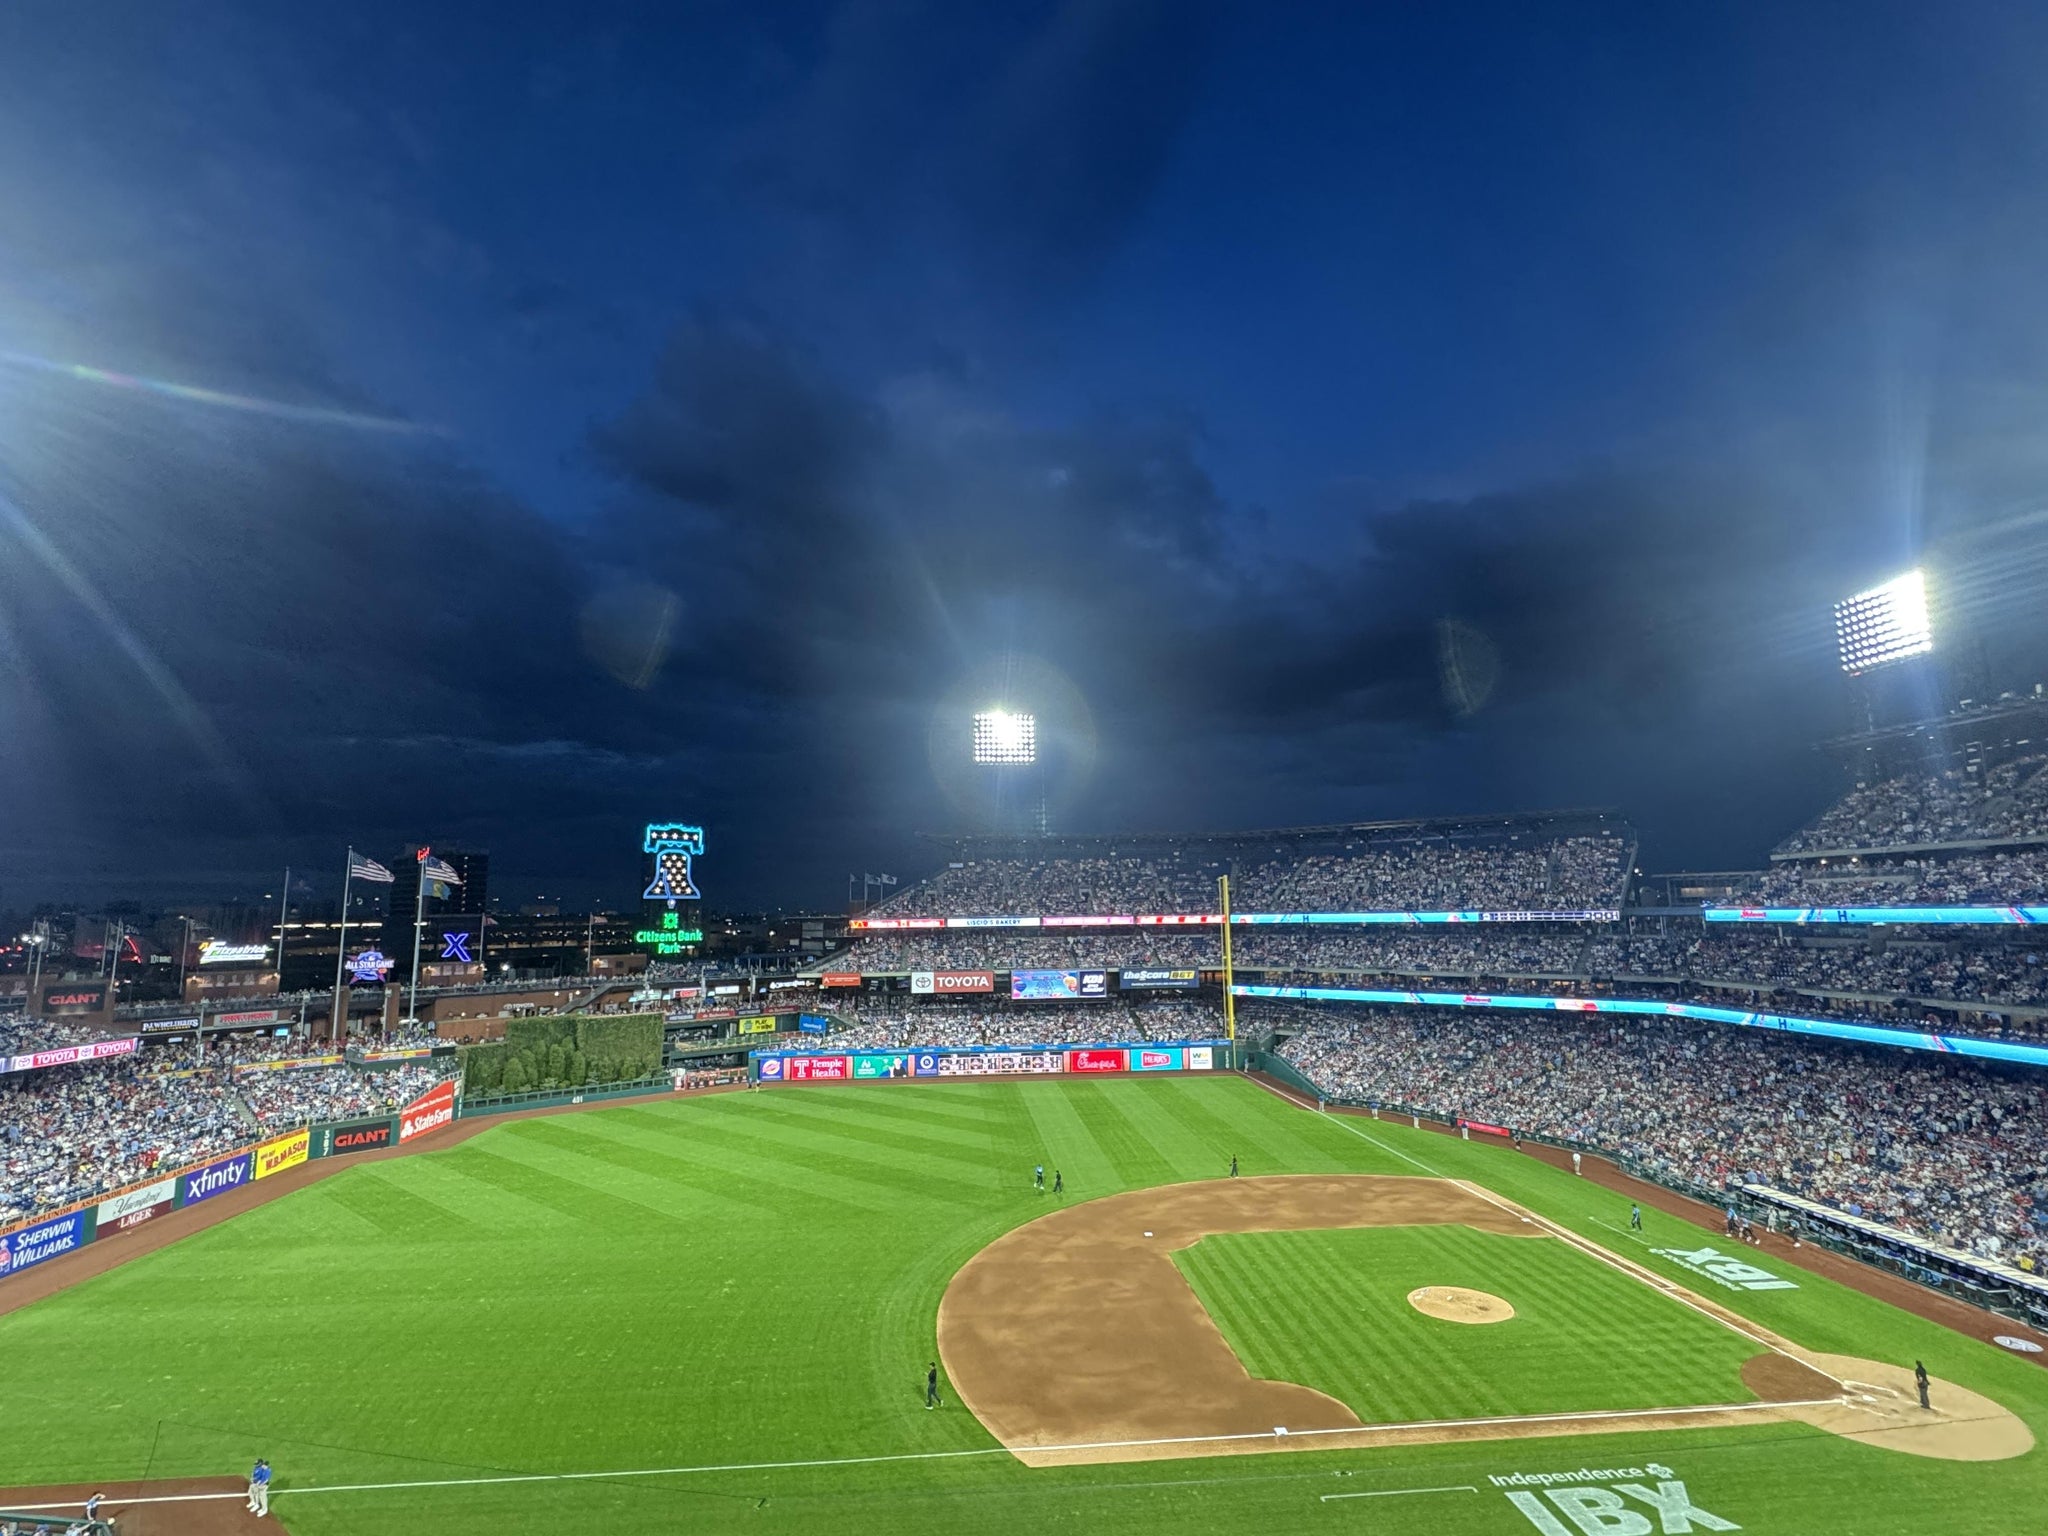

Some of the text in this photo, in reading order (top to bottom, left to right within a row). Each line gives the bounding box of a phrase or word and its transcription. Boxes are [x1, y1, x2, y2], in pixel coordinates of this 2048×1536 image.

[996, 918, 1021, 926] BAKERY
[636, 929, 703, 943] Citizens Bank
[658, 943, 681, 954] Park
[937, 976, 989, 987] TOYOTA
[48, 993, 100, 1005] GIANT
[35, 1042, 131, 1065] TOYOTA TOYOTA
[811, 1059, 842, 1069] Temple
[812, 1069, 840, 1077] Health
[334, 1128, 389, 1147] GIANT
[130, 1175, 166, 1191] ASPLUNDH
[188, 1162, 246, 1198] xfinity
[81, 1189, 122, 1209] ASPLUNDH
[26, 1206, 73, 1227] ASPLUNDH
[119, 1208, 153, 1229] LAGER
[15, 1218, 76, 1250] SHERWIN
[1487, 1467, 1645, 1487] Independence
[1504, 1480, 1743, 1536] IBX
